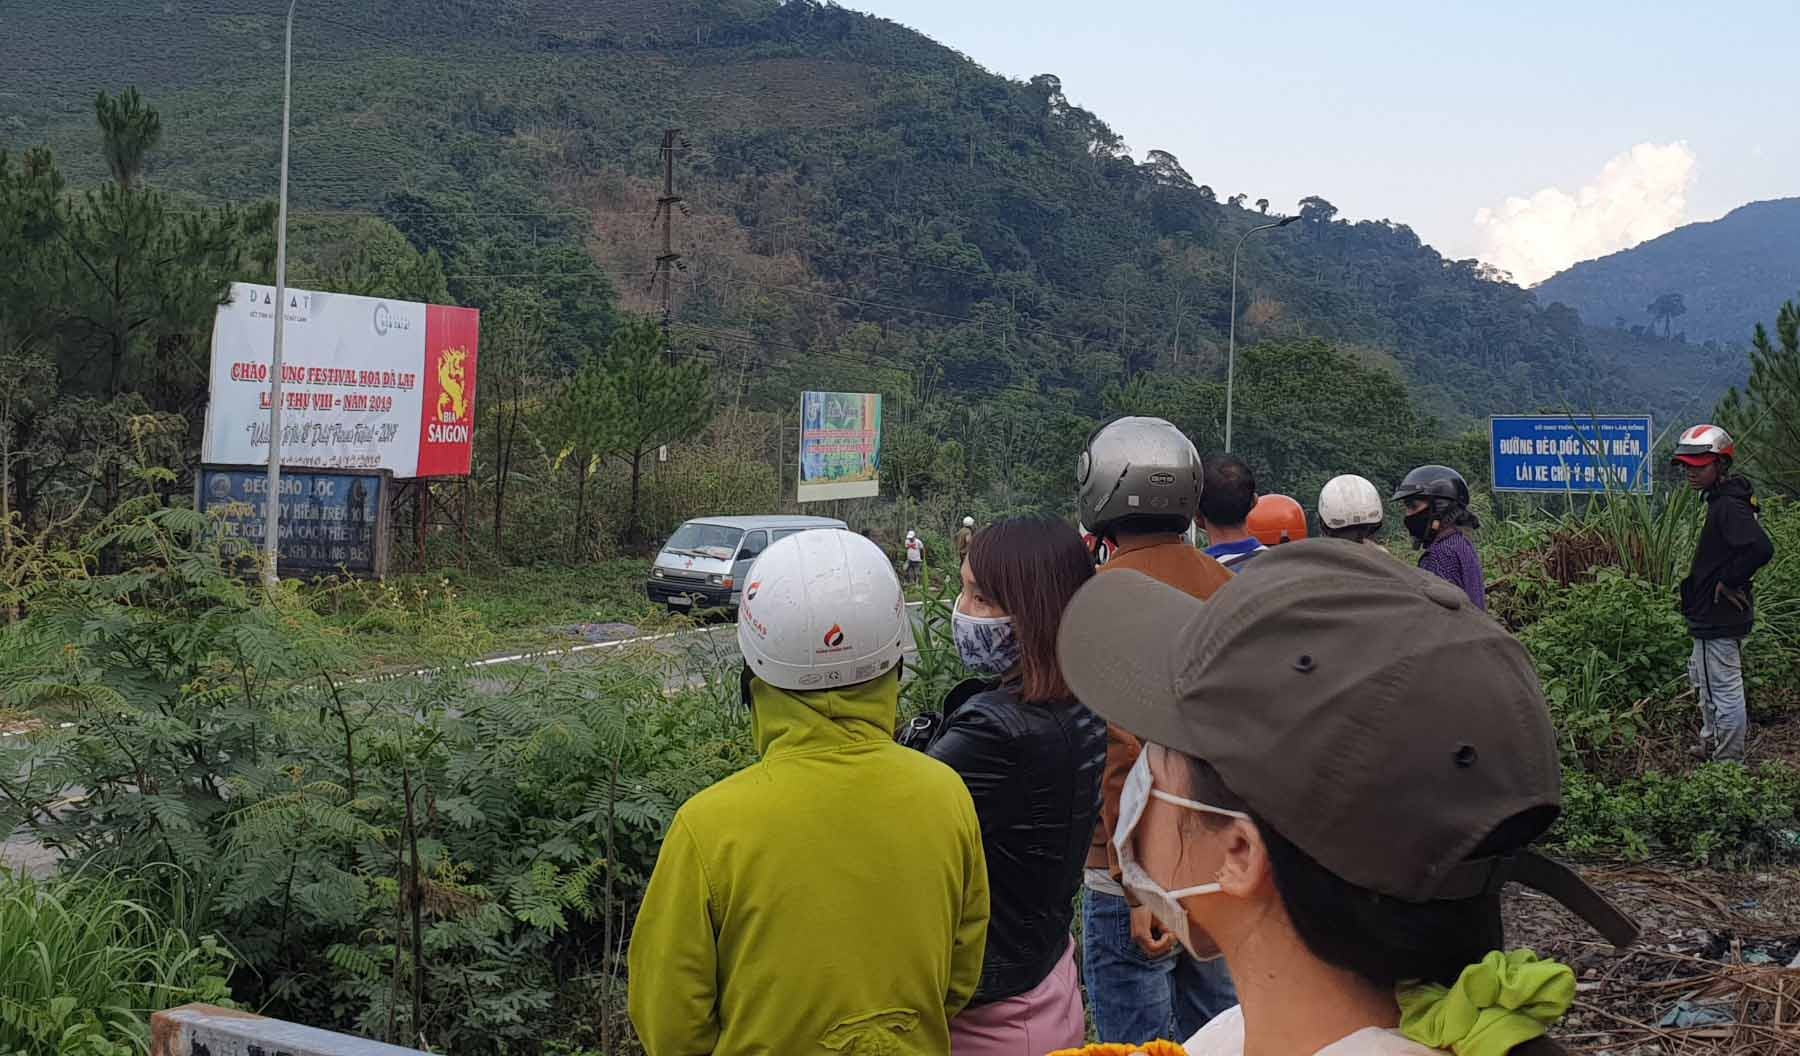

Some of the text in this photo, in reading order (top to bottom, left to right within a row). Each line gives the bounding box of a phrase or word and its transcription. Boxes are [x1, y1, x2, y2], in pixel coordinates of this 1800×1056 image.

[307, 366, 357, 386] FESTIVAL
[359, 370, 380, 387] HOA
[398, 373, 415, 392] LẠT
[313, 393, 332, 411] VIII
[369, 395, 392, 412] 2019
[443, 411, 456, 423] BIA
[427, 423, 468, 443] SAIGON
[1516, 460, 1532, 481] LÁI
[1535, 465, 1549, 481] XE
